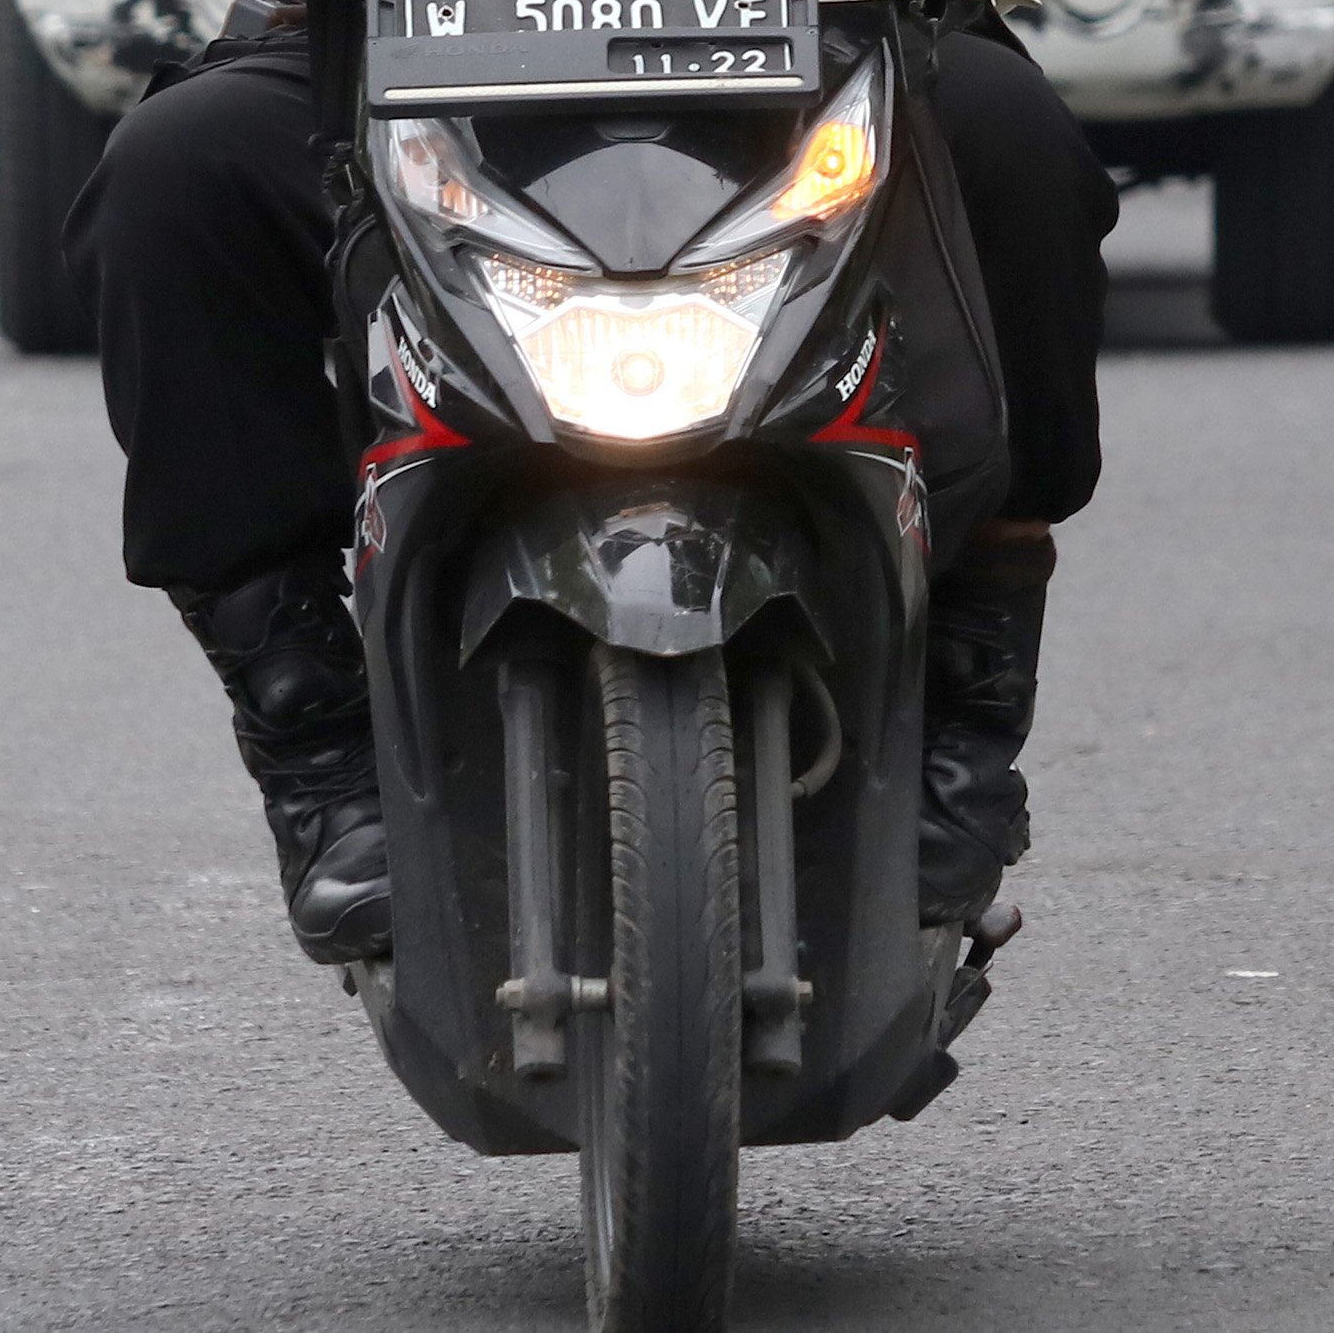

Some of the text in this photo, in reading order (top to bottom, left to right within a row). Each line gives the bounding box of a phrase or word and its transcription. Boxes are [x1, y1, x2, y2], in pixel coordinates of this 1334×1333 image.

[425, 0, 465, 37] W
[398, 336, 437, 408] HONDA
[834, 329, 877, 402] HONDA
